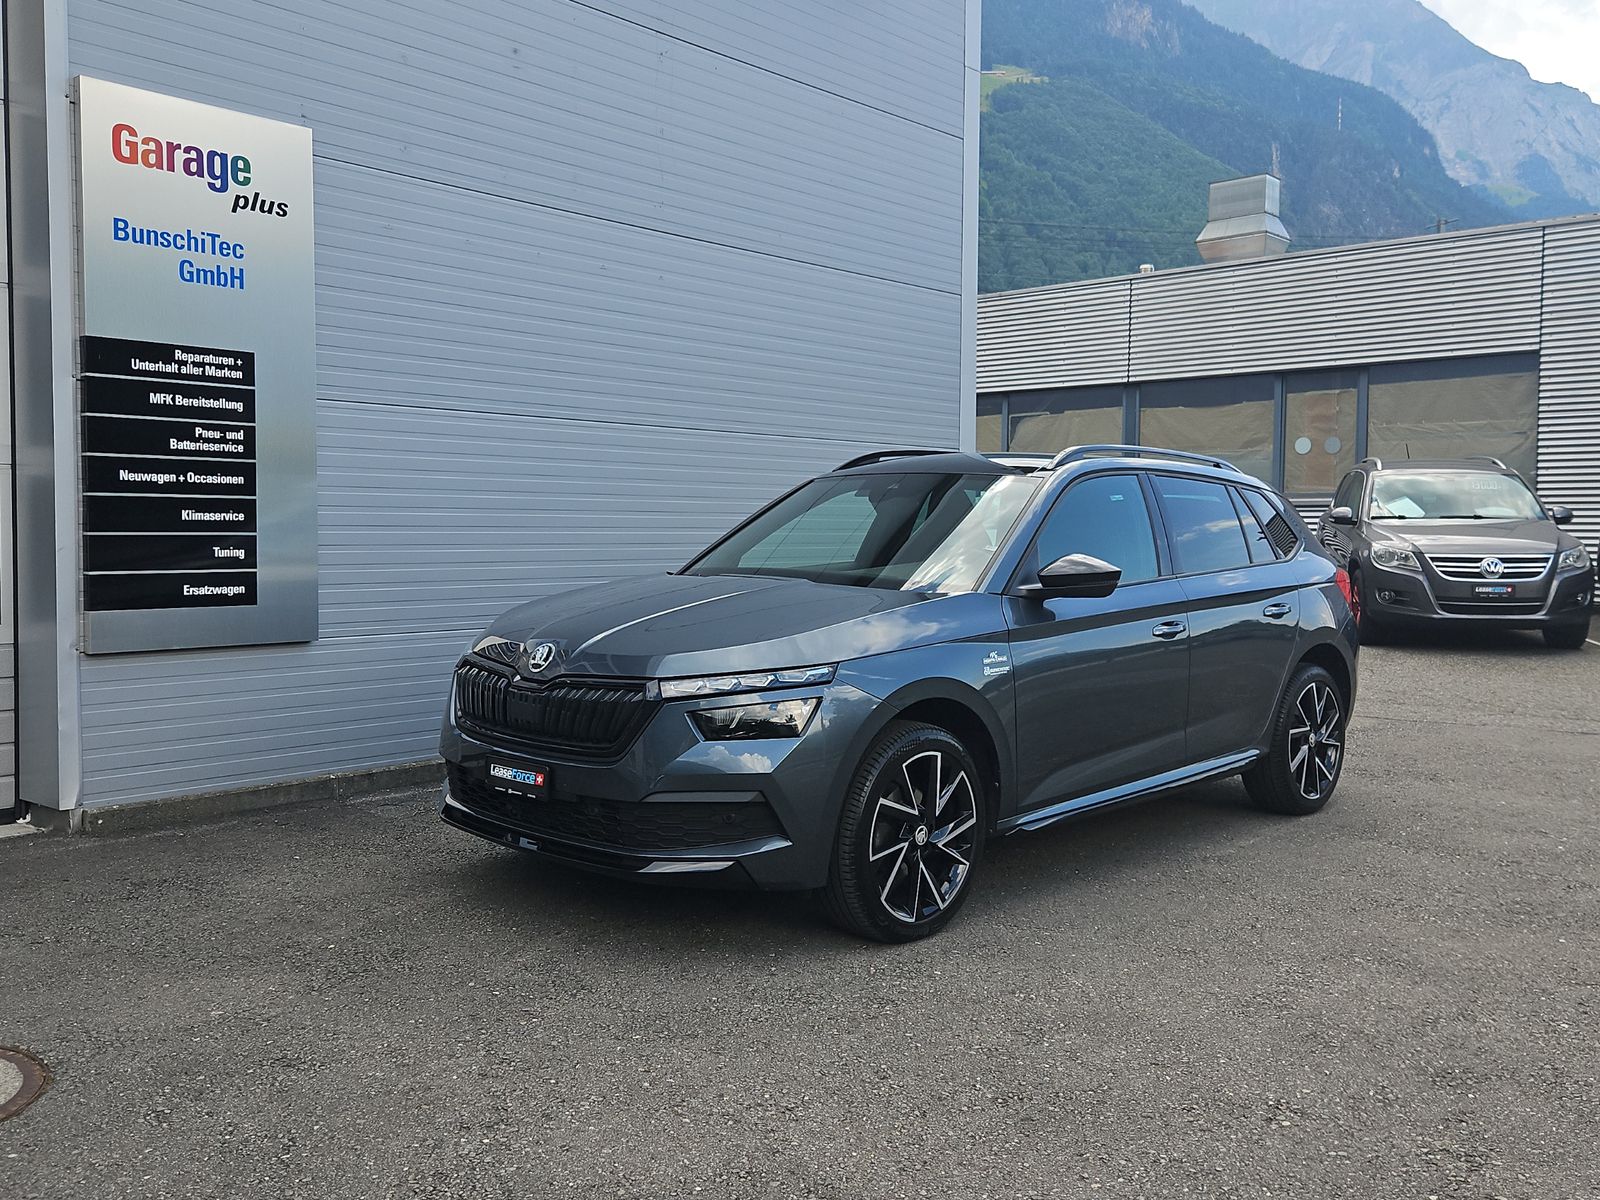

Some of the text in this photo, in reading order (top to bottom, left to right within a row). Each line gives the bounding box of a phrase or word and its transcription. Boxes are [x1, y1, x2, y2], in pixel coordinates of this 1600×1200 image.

[111, 123, 252, 193] Garage
[231, 191, 289, 218] plus
[113, 217, 245, 260] BunschiTec
[178, 259, 245, 290] GmbH
[174, 349, 235, 366] Reparaturen
[131, 358, 243, 379] Unterhalt aller Marken
[149, 392, 244, 412] MFK Bereitstellung
[195, 427, 244, 440] Pneu- und
[169, 438, 244, 453] Batterieservice
[119, 469, 177, 484] Neuwagen
[187, 472, 244, 484] Occasionen
[181, 509, 245, 521] Klimaservice
[212, 546, 245, 560] Tuning
[183, 584, 245, 596] Ersatzwagen
[490, 763, 536, 784] LeaseForce
